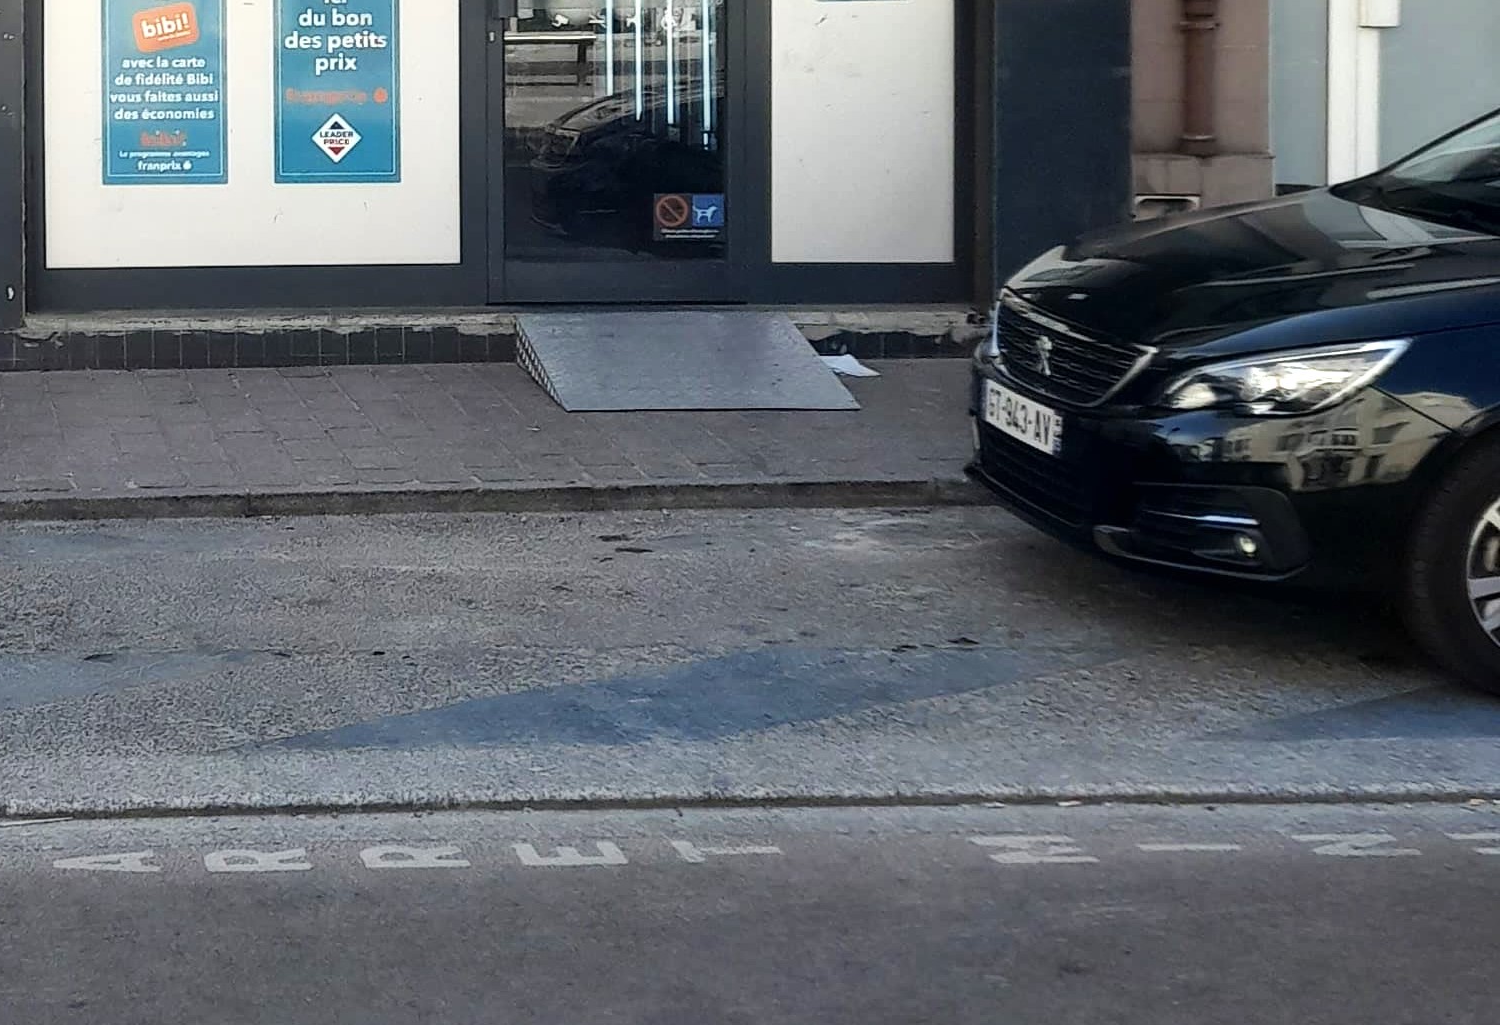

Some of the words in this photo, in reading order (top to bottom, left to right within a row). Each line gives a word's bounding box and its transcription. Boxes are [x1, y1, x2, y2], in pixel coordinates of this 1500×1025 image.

[298, 9, 326, 26] du
[331, 9, 373, 26] bon
[140, 12, 191, 40] bibi!
[284, 31, 322, 49] des
[327, 31, 388, 53] petits
[122, 59, 154, 69] avec
[156, 56, 168, 69] la
[171, 57, 206, 69] carte
[315, 53, 358, 75] prix
[114, 73, 132, 86] de
[134, 72, 184, 86] fidélité
[186, 73, 213, 86] Bibi
[110, 93, 142, 103] vous
[144, 90, 182, 103] faites
[185, 90, 219, 103] aussi
[114, 108, 139, 120] des
[141, 107, 215, 120] économies
[319, 130, 354, 138] LEADER
[138, 160, 182, 172] franprix
